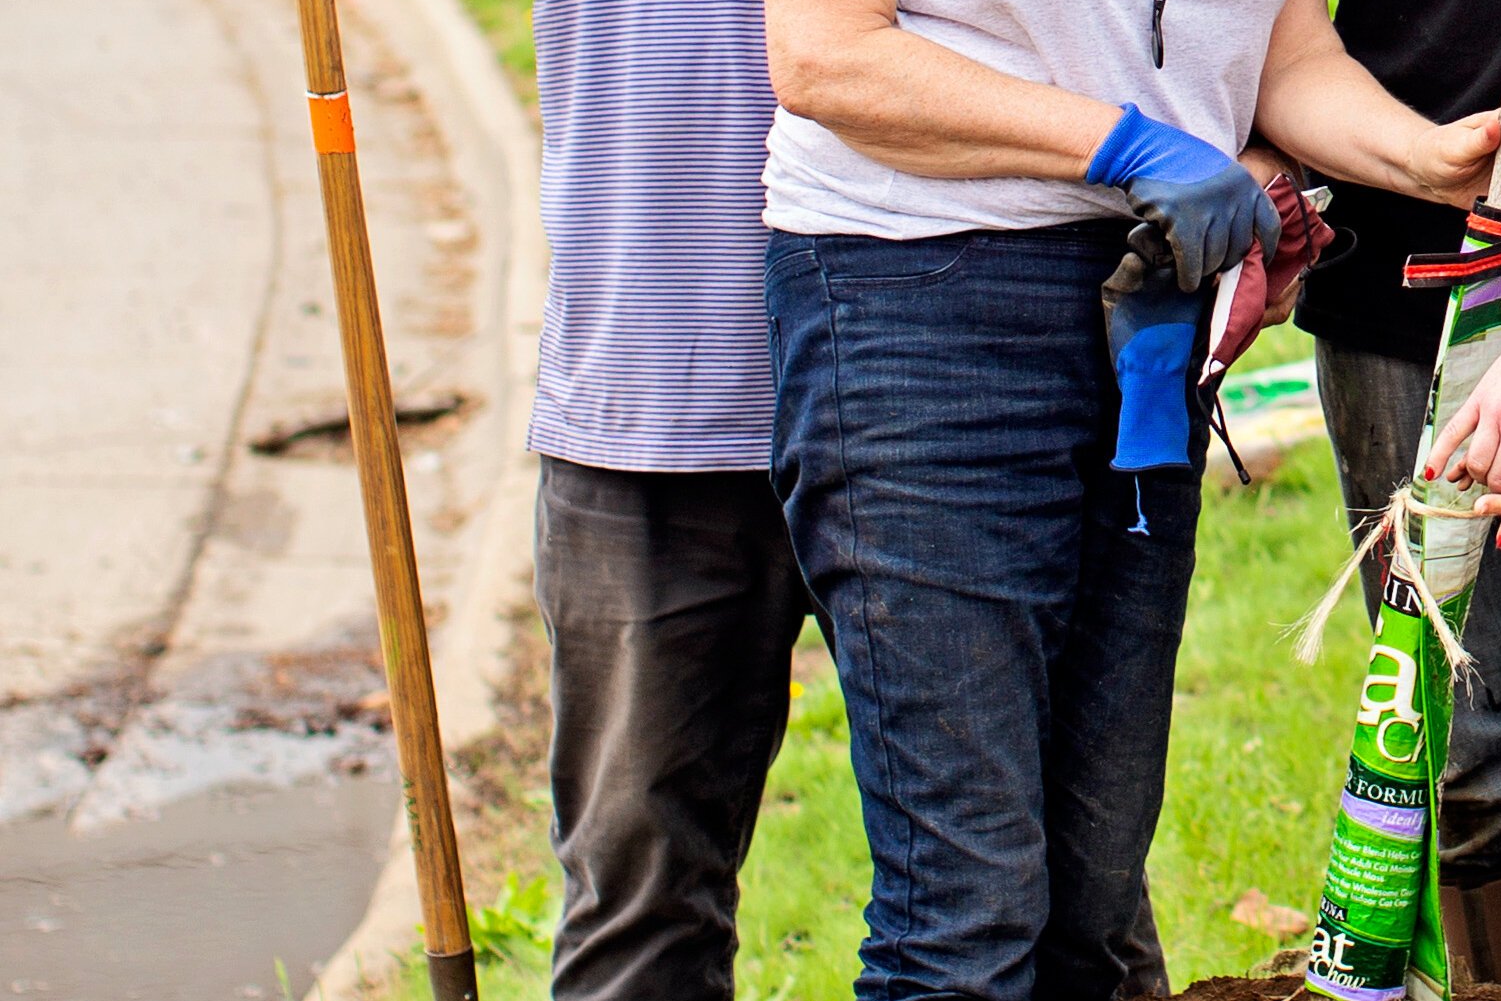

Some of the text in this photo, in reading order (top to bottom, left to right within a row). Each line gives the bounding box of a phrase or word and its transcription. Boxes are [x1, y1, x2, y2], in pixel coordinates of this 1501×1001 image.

[1355, 778, 1428, 806] FORMU
[1382, 811, 1418, 827] ideal
[1373, 862, 1389, 872] Cat
[1362, 870, 1386, 883] Mass
[1378, 898, 1393, 908] Cat
[1309, 926, 1355, 971] at
[1313, 957, 1366, 989] Chow
